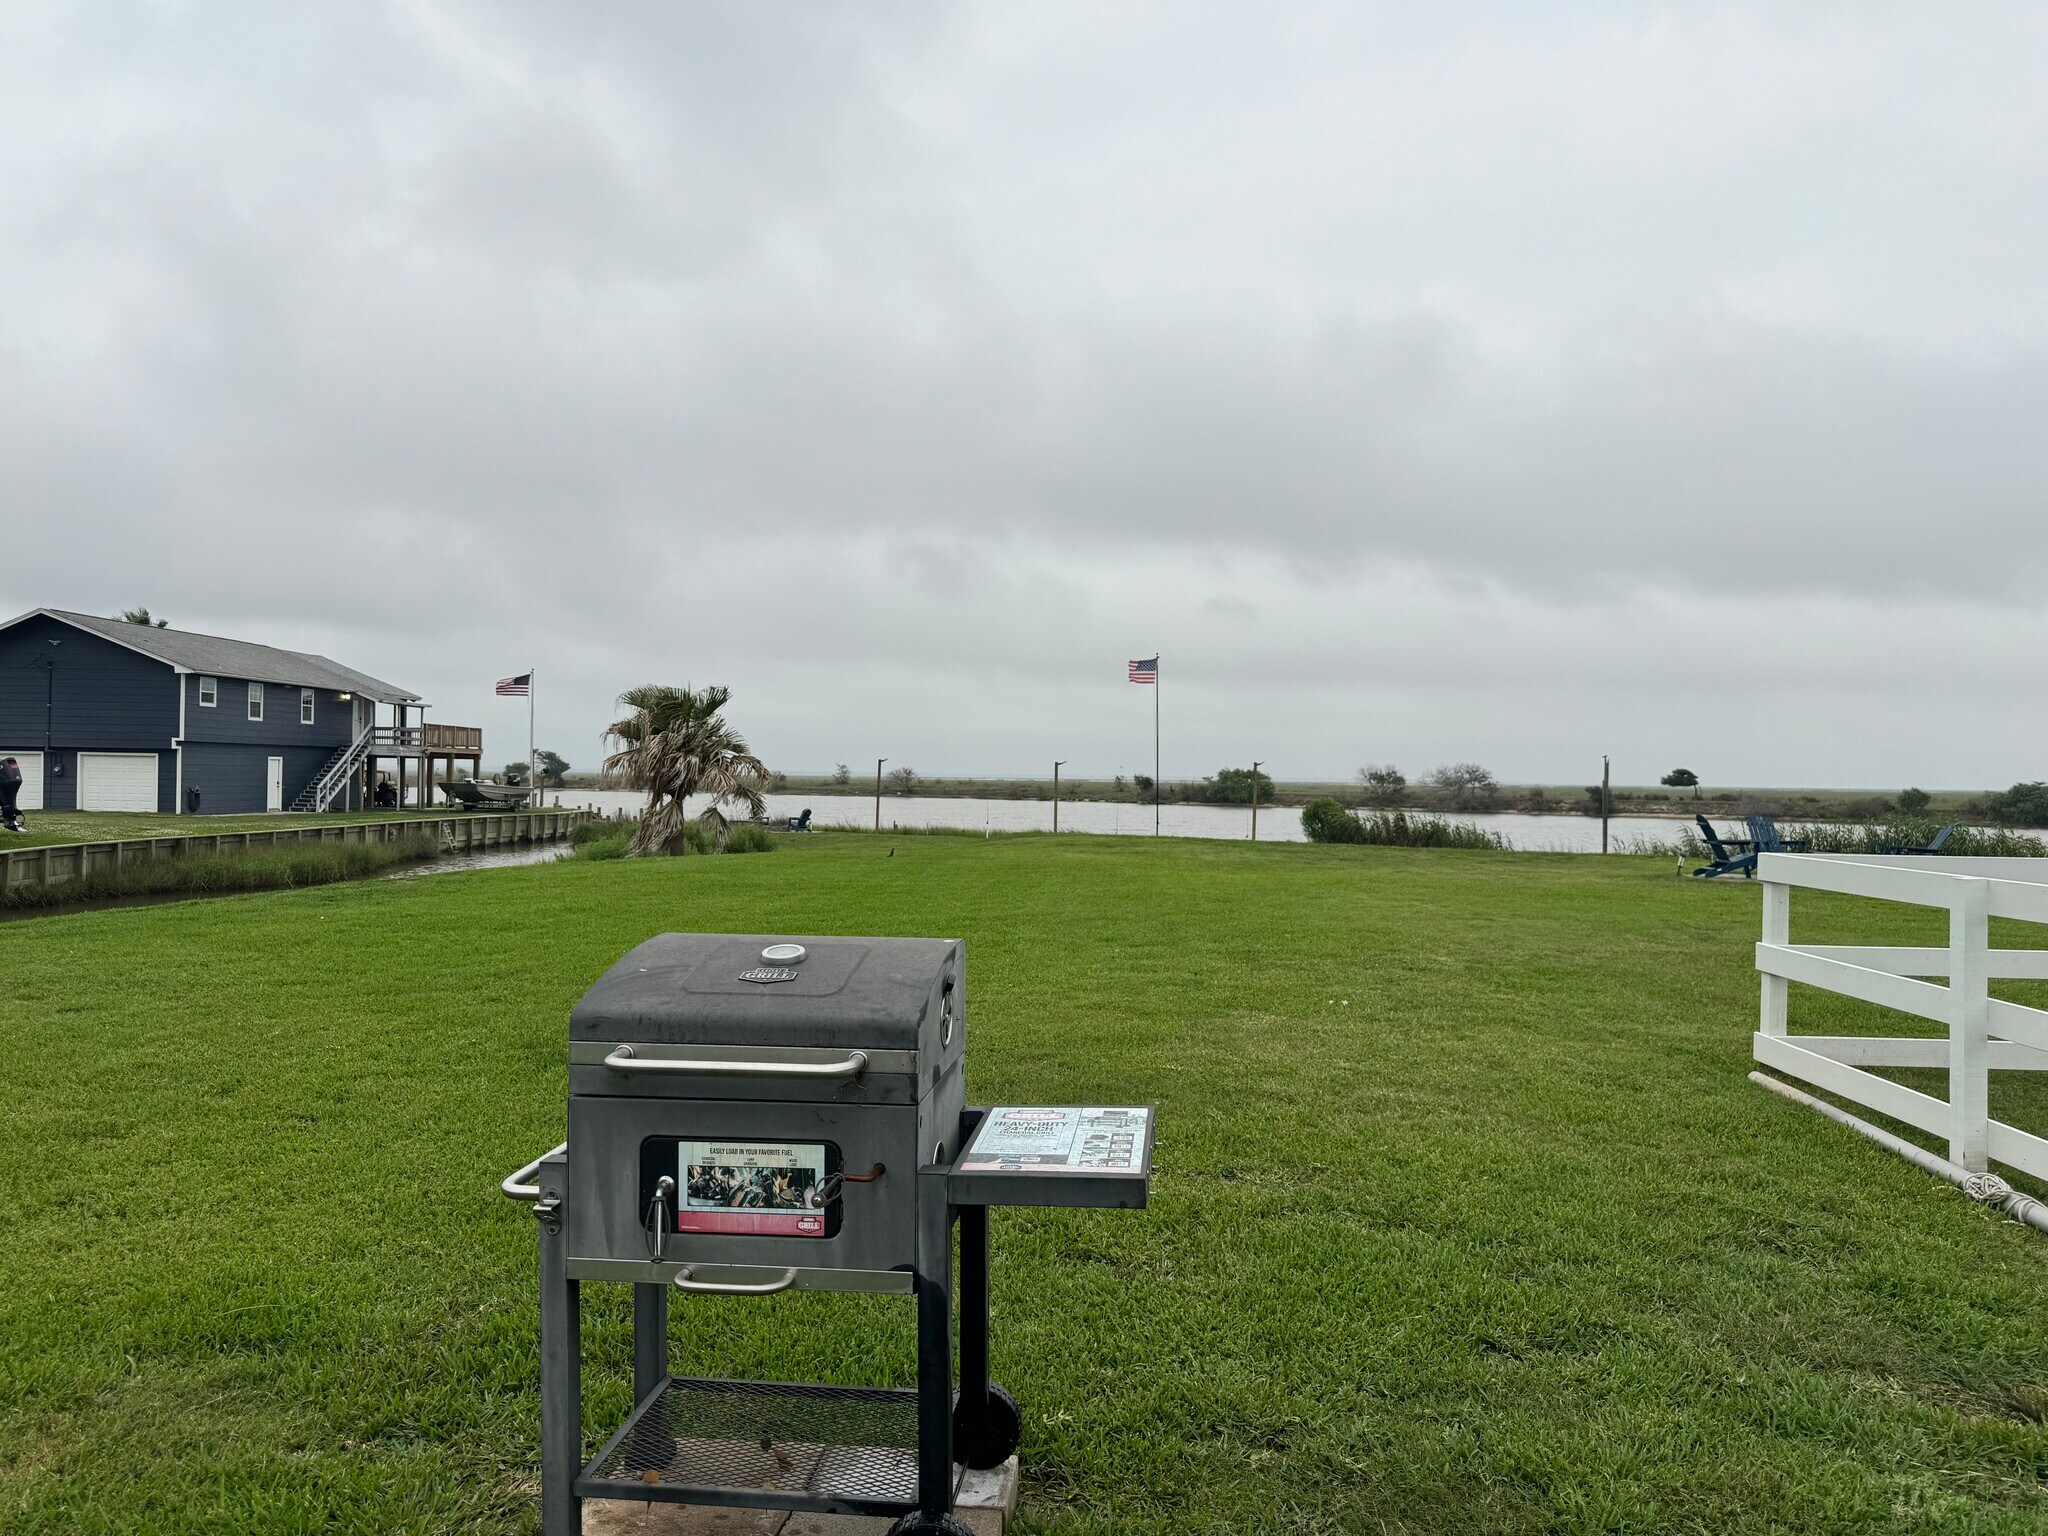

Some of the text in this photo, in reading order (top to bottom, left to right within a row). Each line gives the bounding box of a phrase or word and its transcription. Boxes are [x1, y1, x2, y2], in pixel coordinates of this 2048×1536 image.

[709, 1147, 725, 1155] EASILY
[745, 1148, 758, 1156] YOUR
[781, 1149, 793, 1157] FUEL
